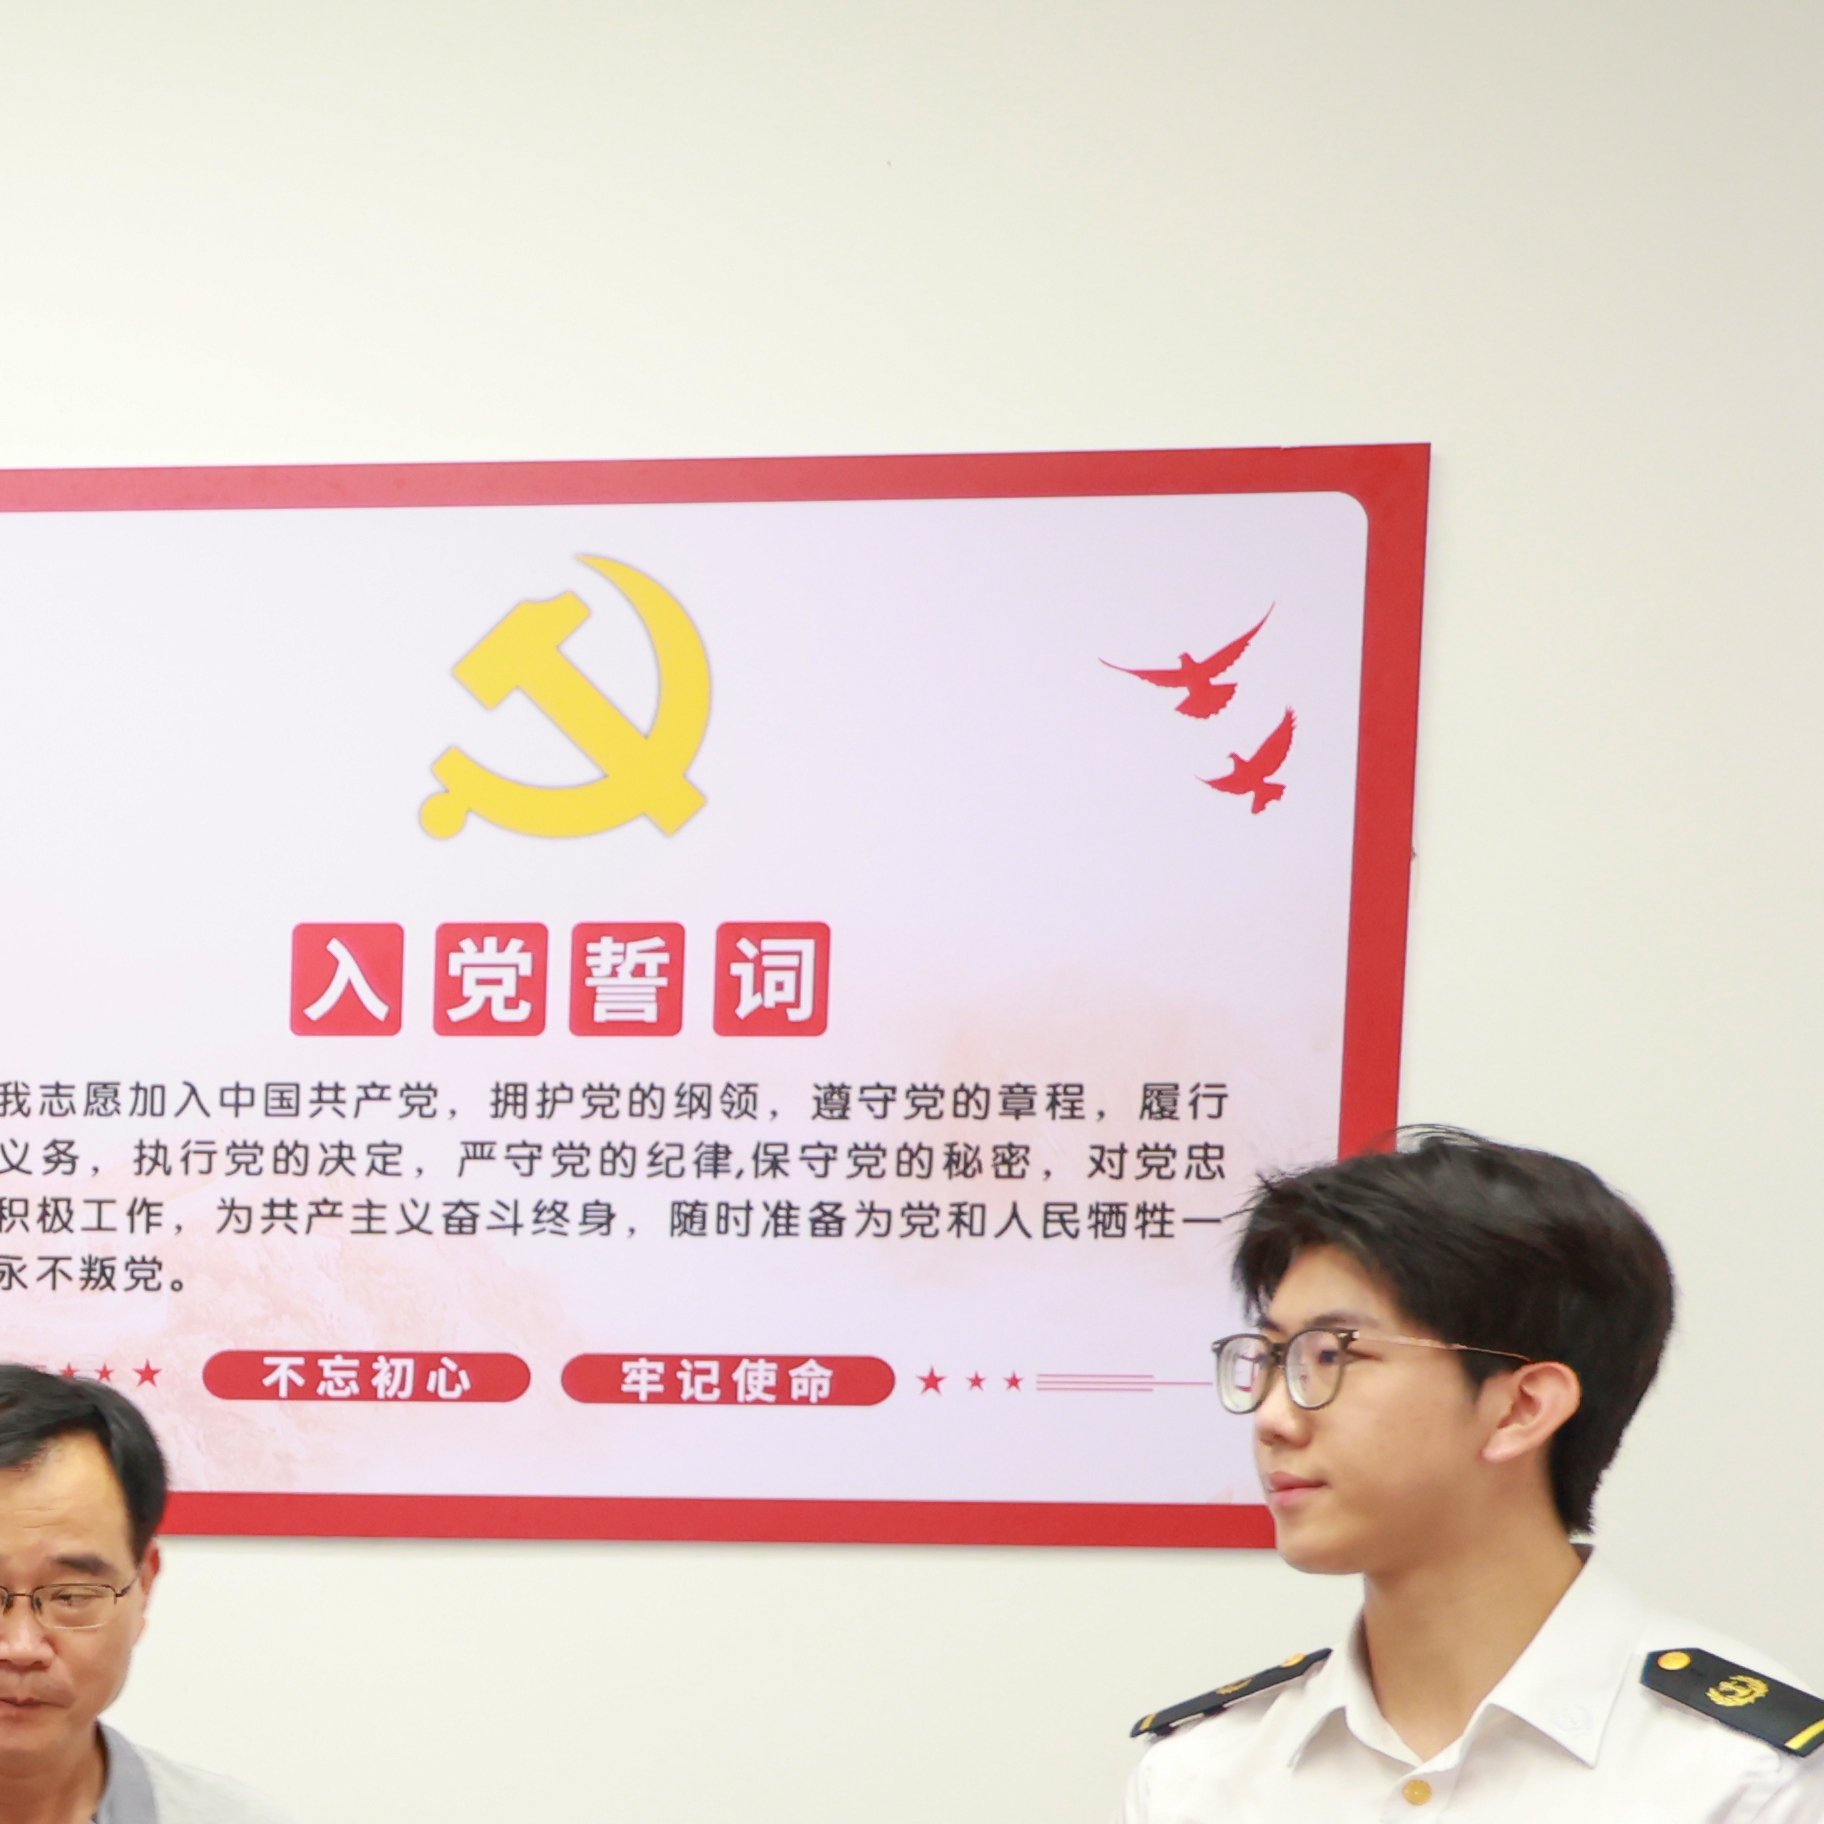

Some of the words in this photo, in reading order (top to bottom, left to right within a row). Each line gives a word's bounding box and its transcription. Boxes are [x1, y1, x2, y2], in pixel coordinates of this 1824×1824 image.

[303, 936, 816, 1023] 入党誓词
[261, 1354, 471, 1400] 不忘初心
[620, 1358, 835, 1405] 牢记使命
